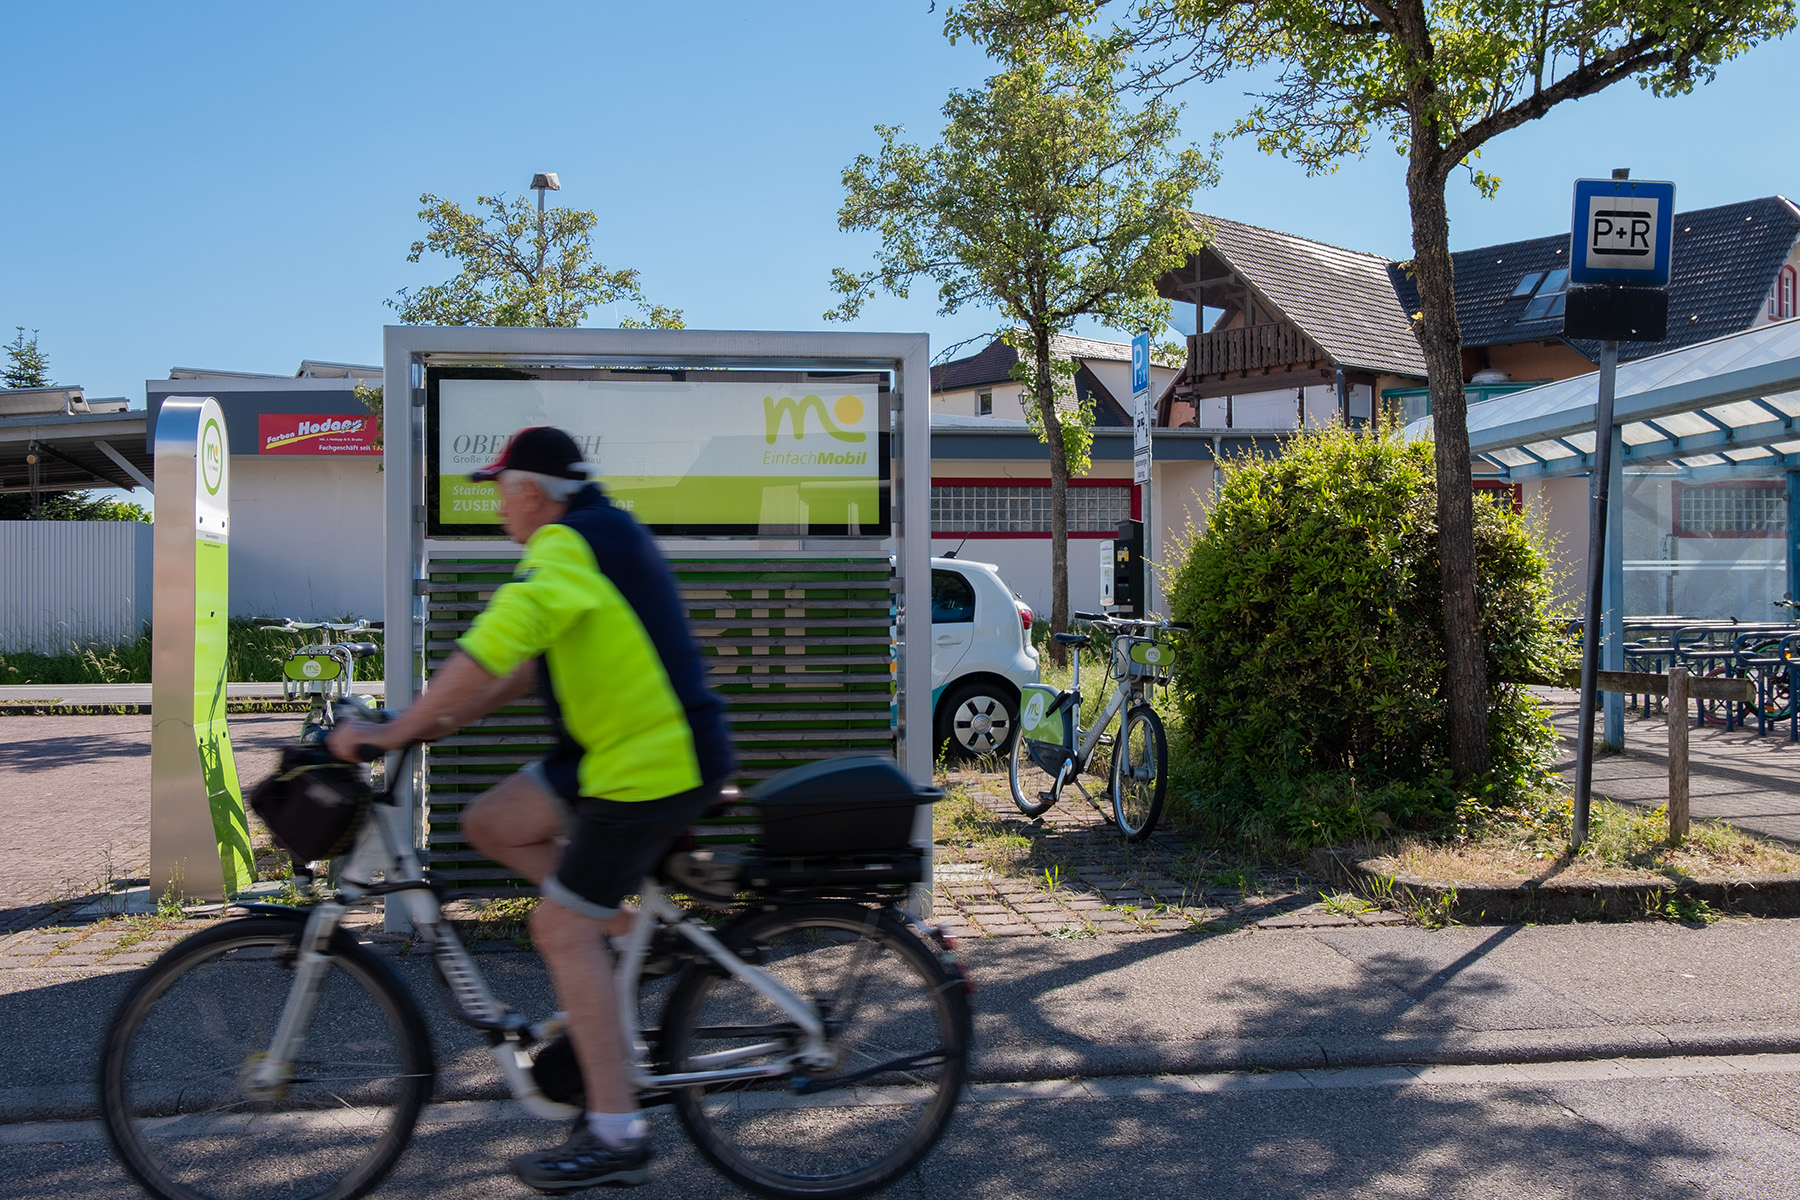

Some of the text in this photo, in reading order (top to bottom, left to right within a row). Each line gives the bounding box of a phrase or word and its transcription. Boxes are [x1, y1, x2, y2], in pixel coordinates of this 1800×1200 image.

[1593, 218, 1651, 248] P+R
[1133, 343, 1143, 387] P
[267, 431, 295, 444] Farben
[298, 418, 362, 436] Hodapp
[319, 444, 359, 452] Fachgeschäft
[453, 454, 482, 464] Große
[762, 449, 868, 465] EinfachMobil
[453, 485, 495, 496] Station
